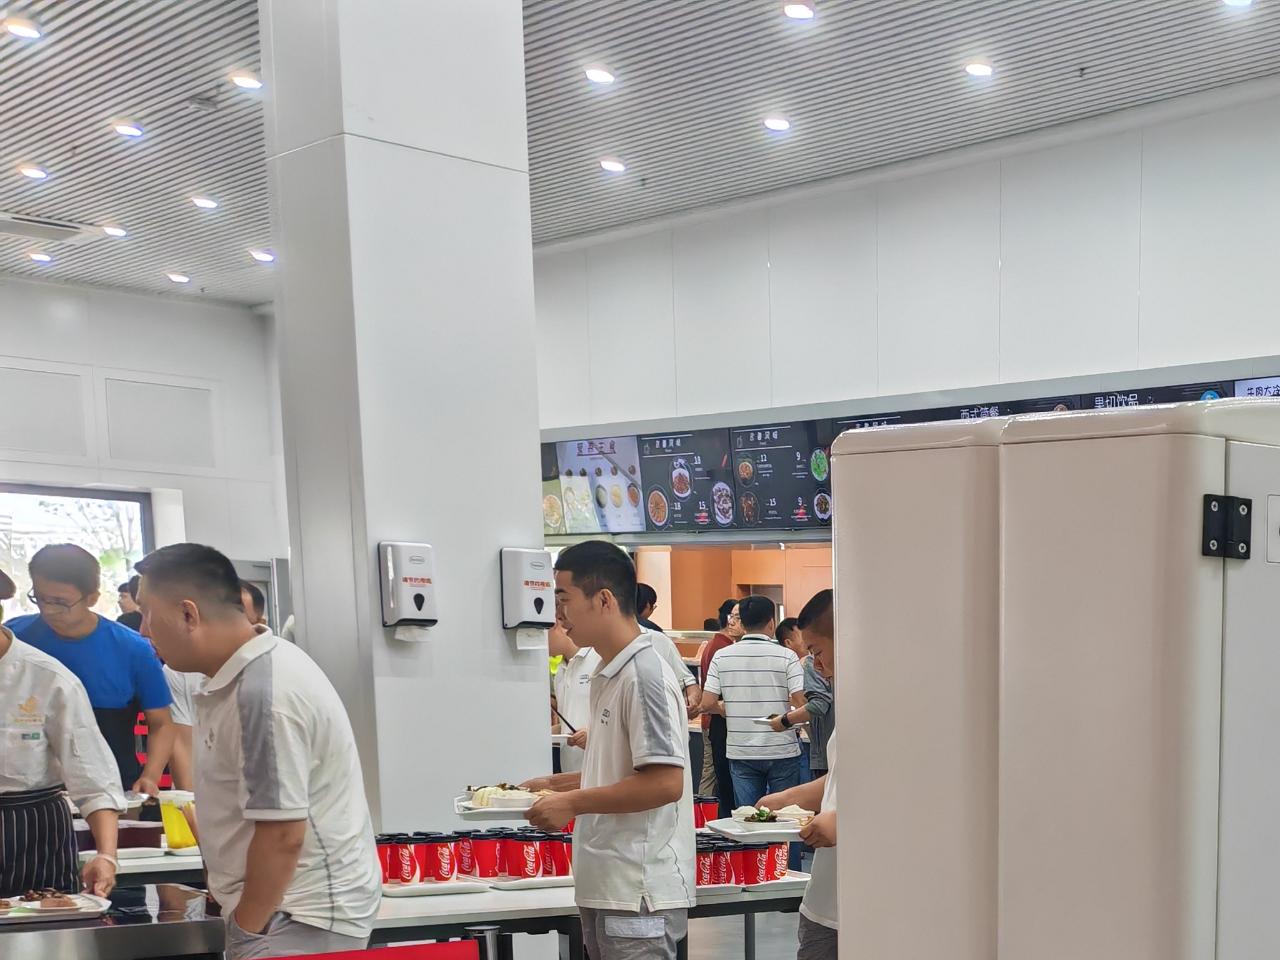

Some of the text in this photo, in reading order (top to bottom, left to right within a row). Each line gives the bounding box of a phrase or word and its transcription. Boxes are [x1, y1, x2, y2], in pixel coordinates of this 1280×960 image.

[398, 847, 412, 880] Coca-Cola
[437, 845, 451, 878] Coca-Cola
[523, 845, 536, 877] Coca-Cola
